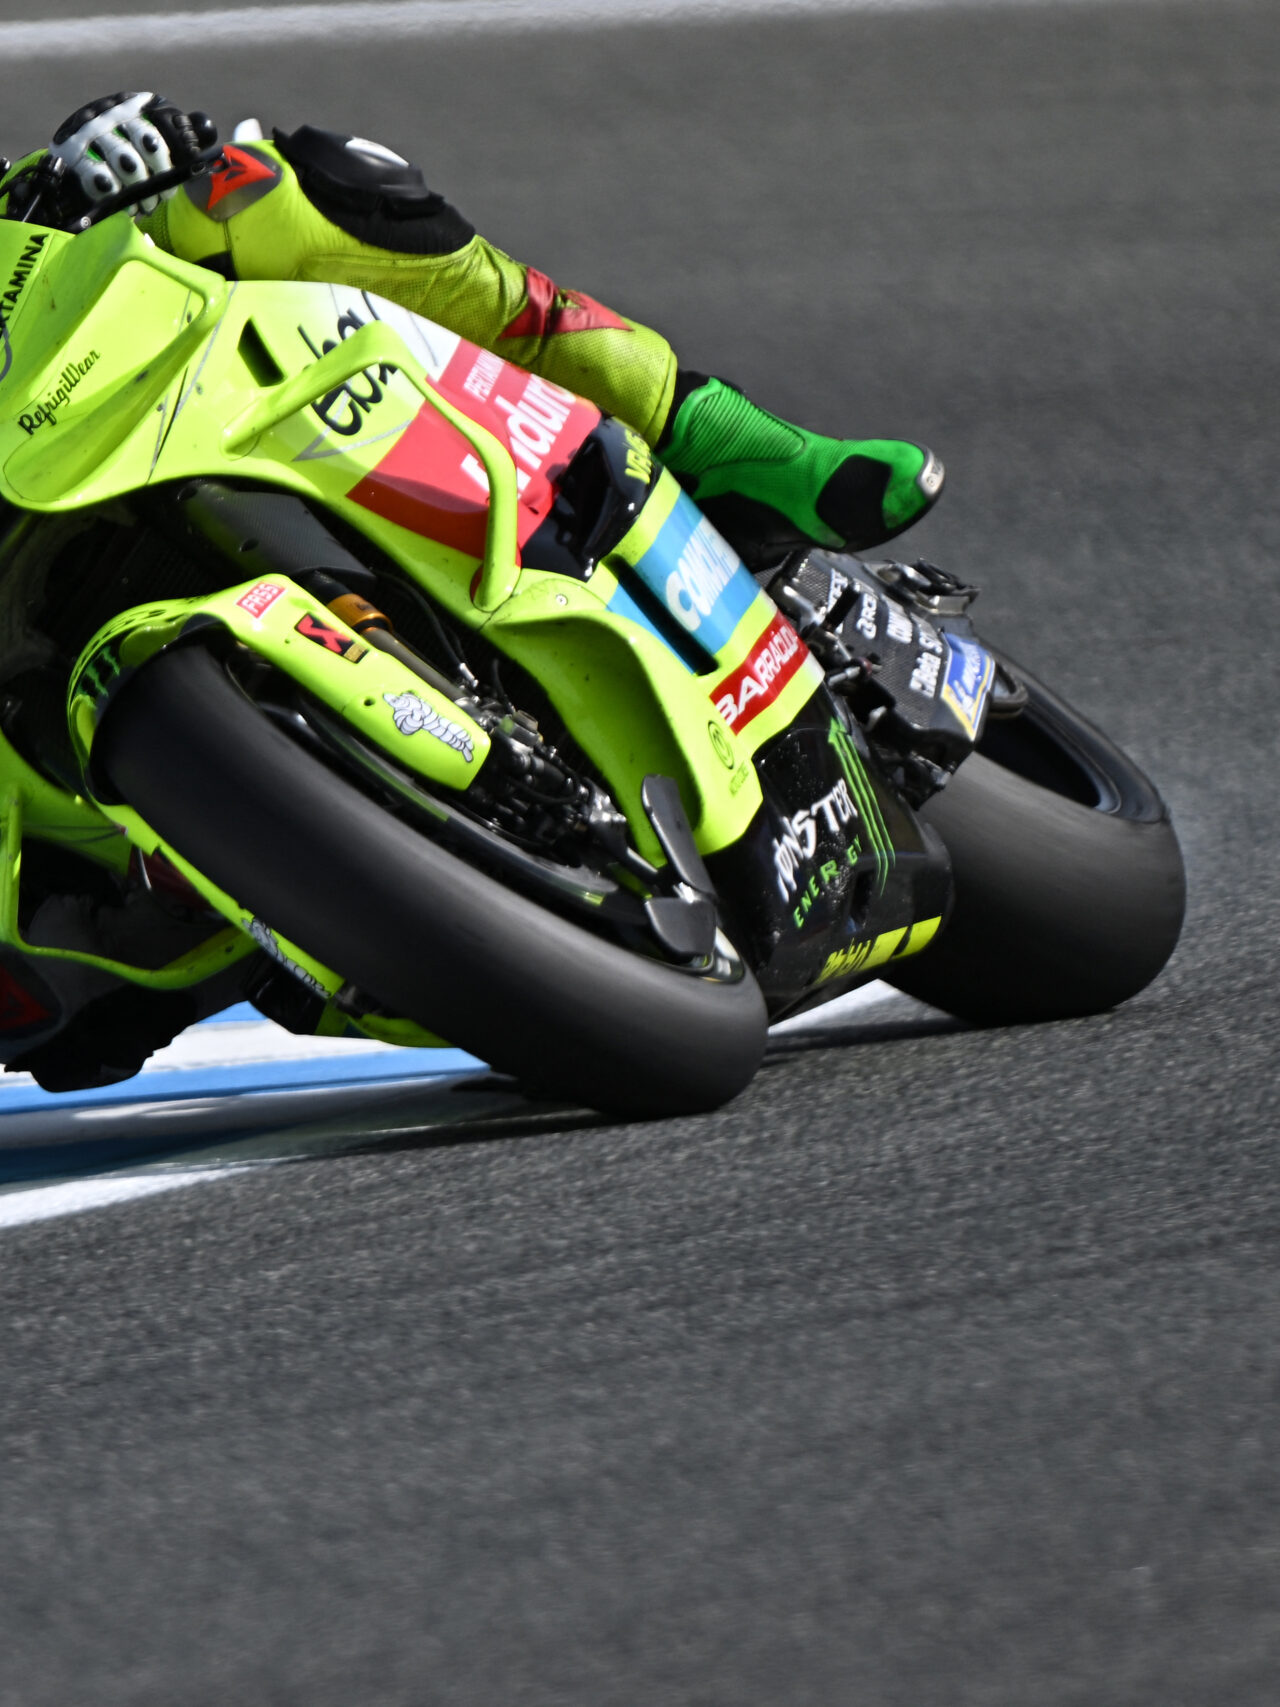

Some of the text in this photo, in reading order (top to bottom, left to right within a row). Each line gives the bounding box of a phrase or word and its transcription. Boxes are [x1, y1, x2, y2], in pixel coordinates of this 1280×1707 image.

[18, 349, 101, 435] RefrigiWear
[462, 349, 506, 401] PERTAMIN
[793, 835, 862, 929] ENERGY
